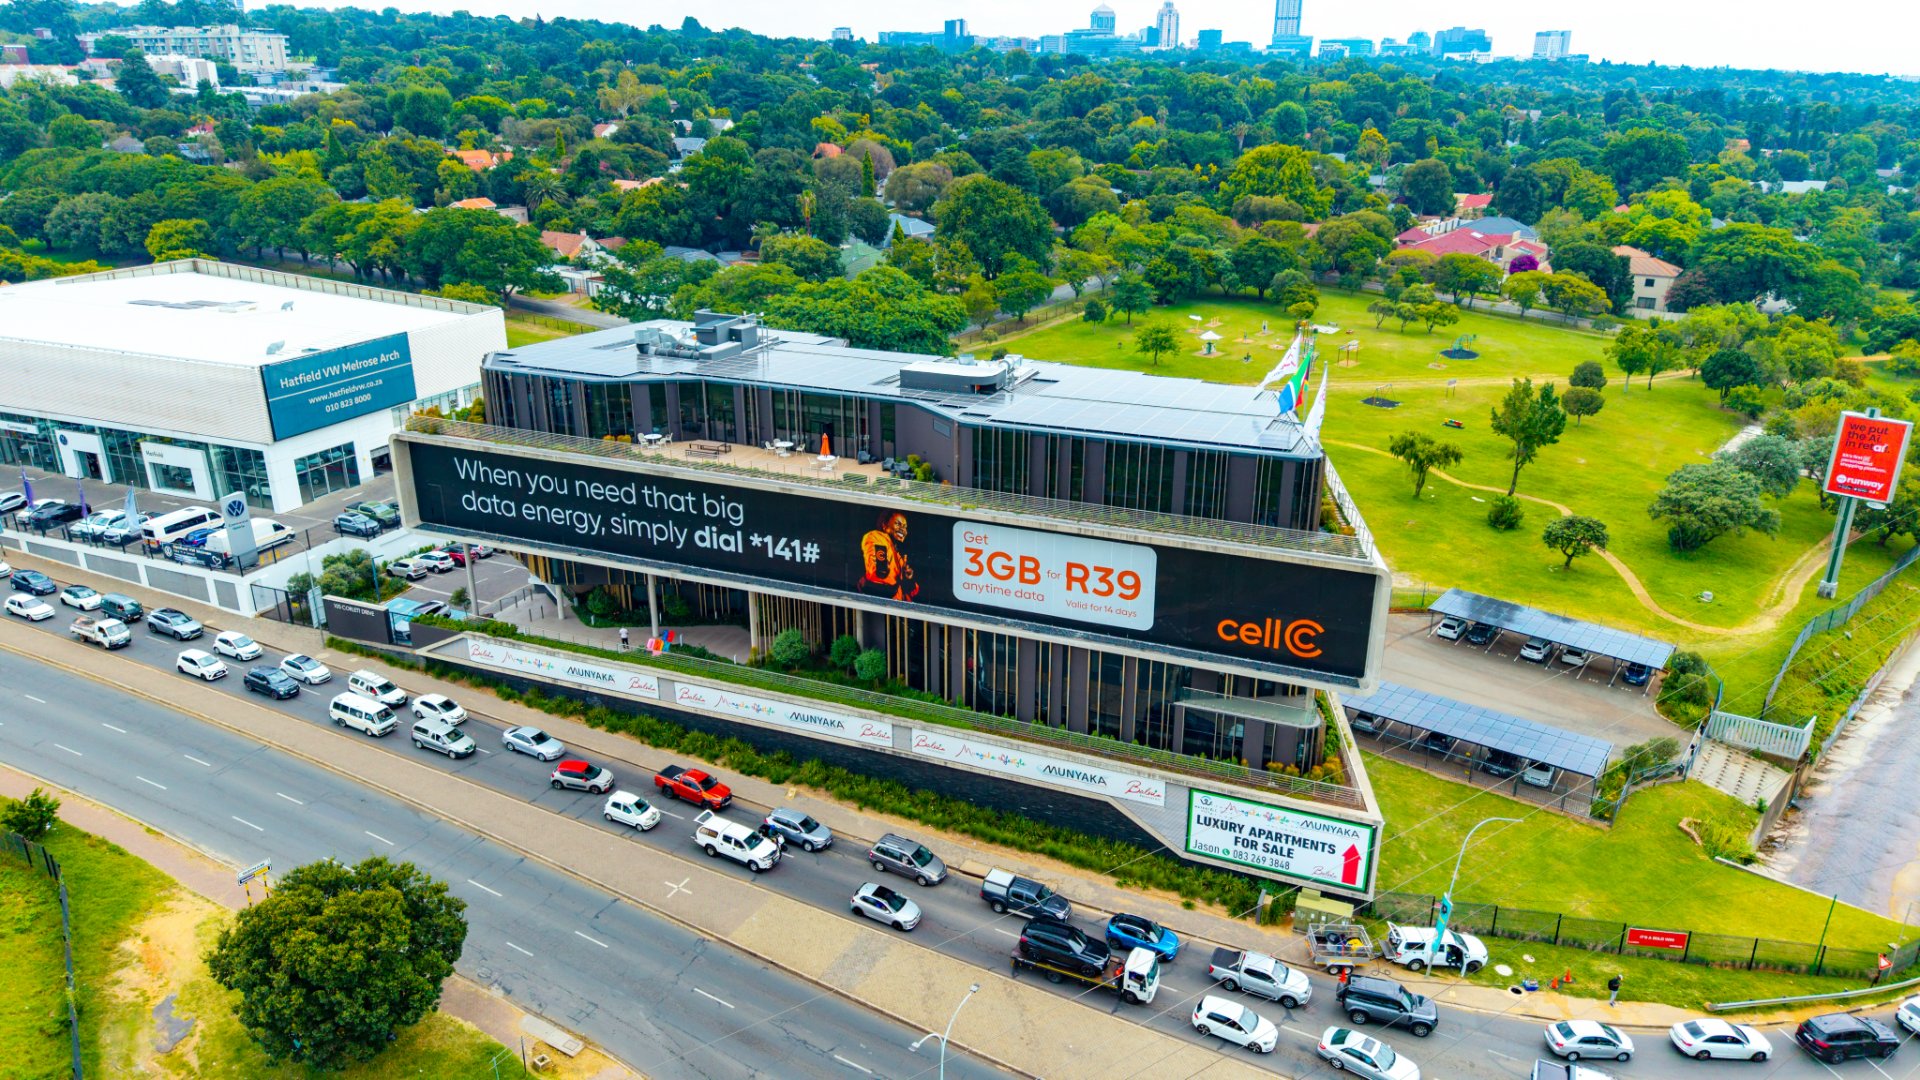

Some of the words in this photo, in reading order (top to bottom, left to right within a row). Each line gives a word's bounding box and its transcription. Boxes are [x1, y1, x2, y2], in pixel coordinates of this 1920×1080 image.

[279, 370, 322, 389] Hatfield
[322, 364, 340, 378] VW
[342, 356, 379, 374] Melrose
[379, 350, 400, 364] Arch
[308, 378, 383, 405] www.hatfieldvw.co.za
[325, 403, 340, 413] 010
[339, 398, 354, 409] 823
[354, 393, 372, 405] 8000
[1847, 431, 1867, 440] the
[1850, 423, 1866, 431] we
[1868, 426, 1889, 435] put
[1845, 440, 1856, 448] in
[453, 456, 522, 488] When
[525, 472, 568, 495] you
[575, 482, 637, 505] need
[641, 485, 698, 515] that
[702, 492, 744, 527] big
[1846, 476, 1884, 491] runway
[461, 490, 516, 518] data
[521, 502, 606, 536] energy,
[610, 512, 688, 550] simply
[694, 525, 743, 554] dial
[963, 530, 989, 546] Get
[964, 546, 1042, 585] 3GB
[1046, 569, 1061, 580] for
[1065, 561, 1141, 601] R39
[962, 579, 1012, 597] anytime
[1014, 588, 1045, 602] data
[1065, 599, 1088, 610] Valid
[1090, 603, 1103, 612] for
[1104, 604, 1113, 614] 14
[1115, 606, 1137, 618] days
[566, 665, 616, 684] MUNYAKA
[789, 711, 845, 730] MUNYAKA
[1042, 764, 1107, 787] MUNYAKA
[1196, 814, 1245, 834] LUXURY
[1248, 826, 1336, 855] APARTMENTS
[1300, 819, 1360, 839] MUNYAKA
[1192, 839, 1220, 855] Jason
[1232, 848, 1249, 860] 083
[1250, 852, 1267, 865] 269
[1269, 856, 1290, 870] 3848
[1234, 835, 1259, 851] FOR
[1262, 842, 1294, 859] SALE
